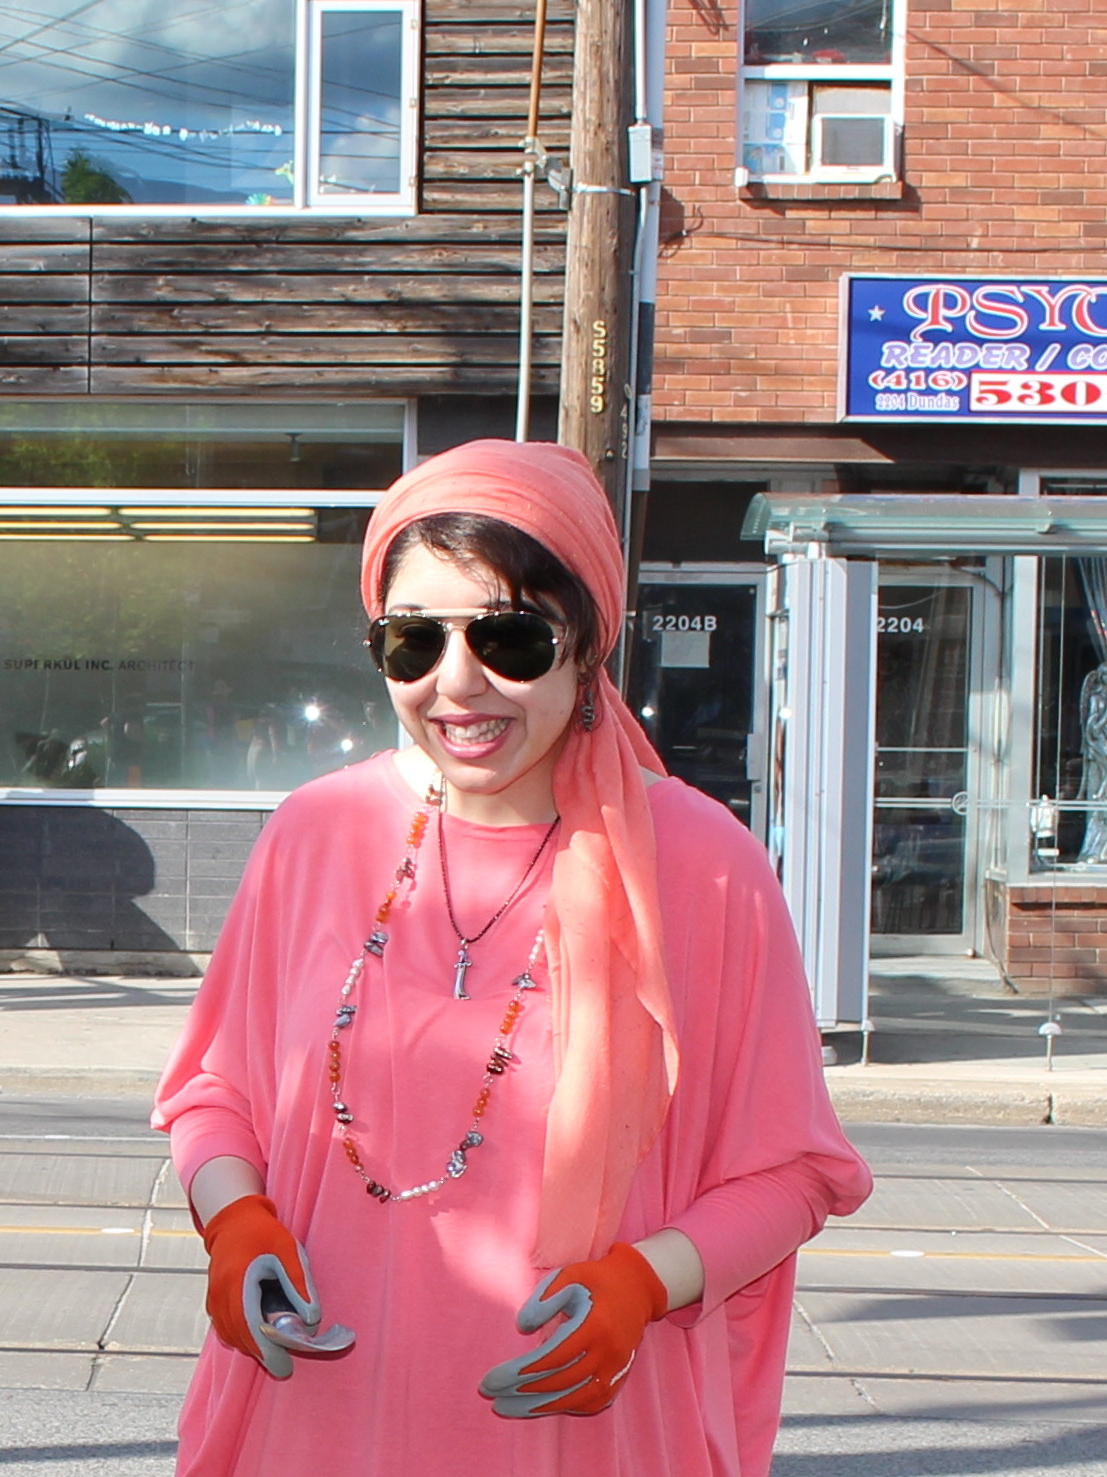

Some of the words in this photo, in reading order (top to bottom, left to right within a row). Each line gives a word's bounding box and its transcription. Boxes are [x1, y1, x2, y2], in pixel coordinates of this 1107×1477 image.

[902, 284, 1107, 341] PSYC
[590, 320, 607, 414] S5859
[880, 341, 1031, 369] READER
[1034, 343, 1061, 371] /
[868, 370, 968, 391] (416)
[907, 392, 960, 411] Dundas
[652, 615, 718, 632] 2204B
[876, 616, 925, 633] 2204
